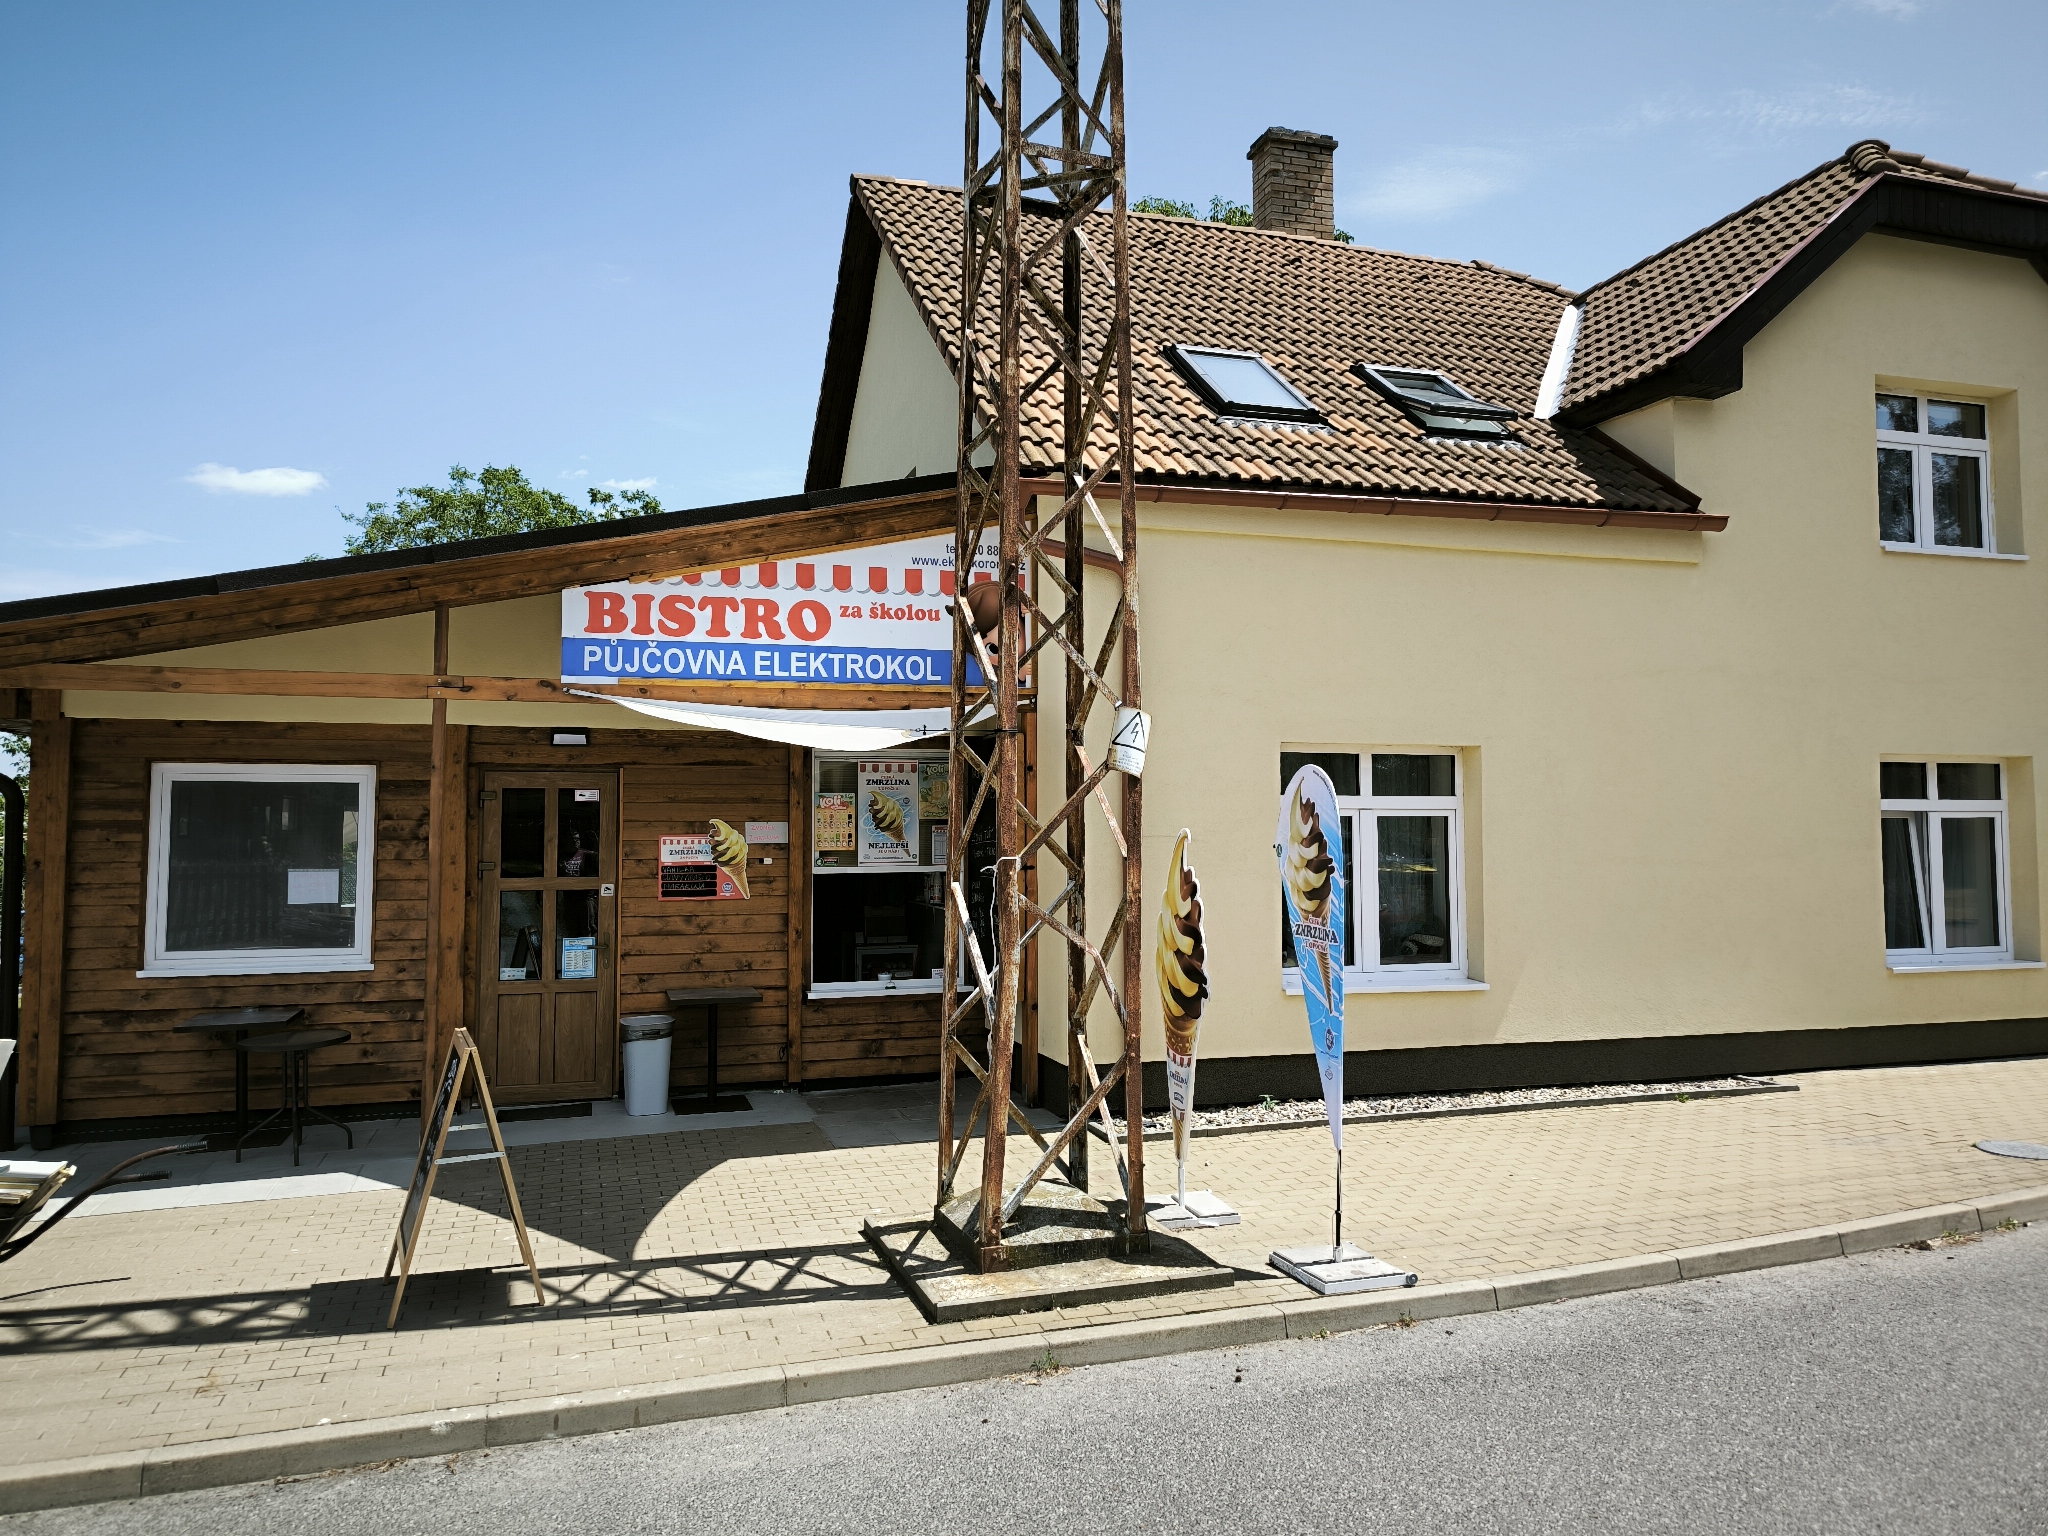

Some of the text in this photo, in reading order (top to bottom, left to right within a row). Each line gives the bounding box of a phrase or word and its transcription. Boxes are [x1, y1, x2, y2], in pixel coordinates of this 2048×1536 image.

[583, 590, 832, 642] BISTRO
[839, 602, 941, 623] za školou
[583, 638, 942, 682] PŮJČOVNA ELEKTROKOL
[865, 778, 911, 786] ZMRZLINA
[867, 840, 909, 850] NEJLEPŠÍ
[1294, 923, 1339, 944] ZMRZLINA
